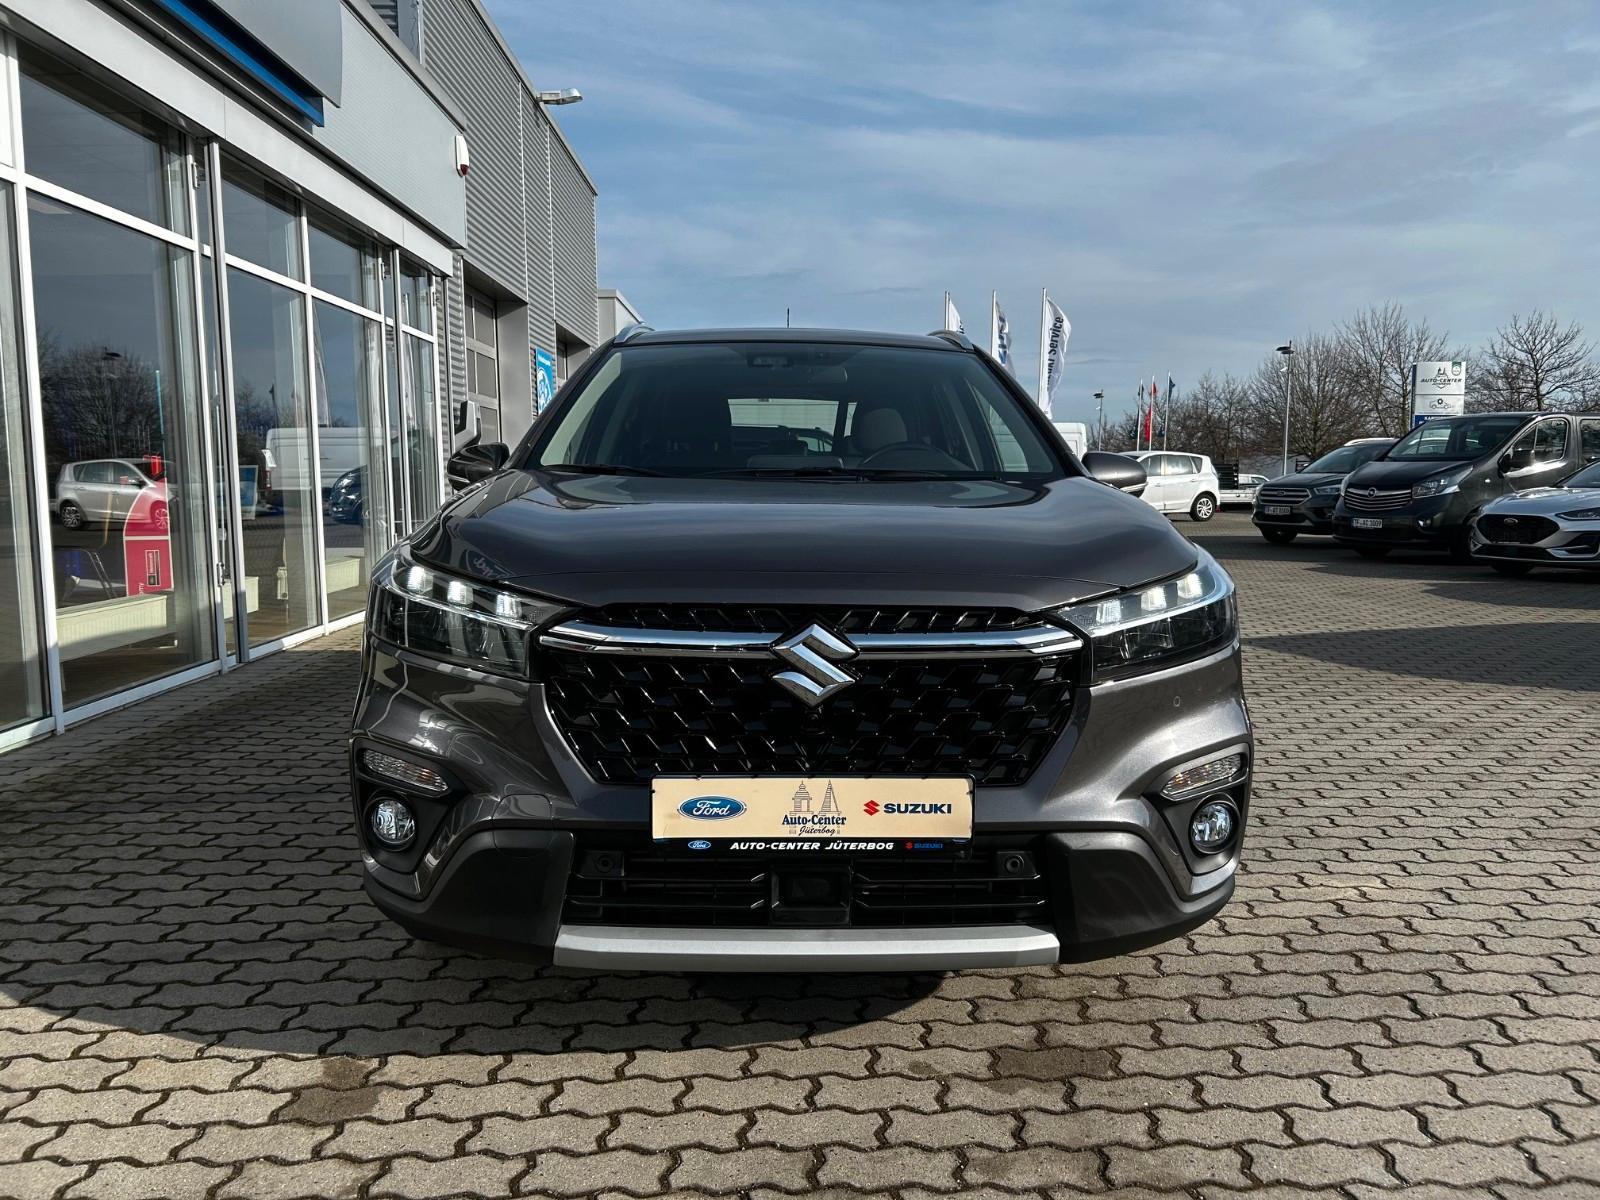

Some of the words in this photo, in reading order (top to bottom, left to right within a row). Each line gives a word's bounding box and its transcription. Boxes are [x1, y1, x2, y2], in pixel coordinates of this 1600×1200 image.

[1047, 316, 1064, 356] Service
[692, 800, 731, 816] Ford
[884, 803, 952, 814] SUZUKI
[782, 814, 847, 826] Auto-Center
[798, 825, 837, 837] Jüterbog
[730, 842, 820, 850] AUTO-CENTER
[825, 840, 895, 850] JÜTERBOG
